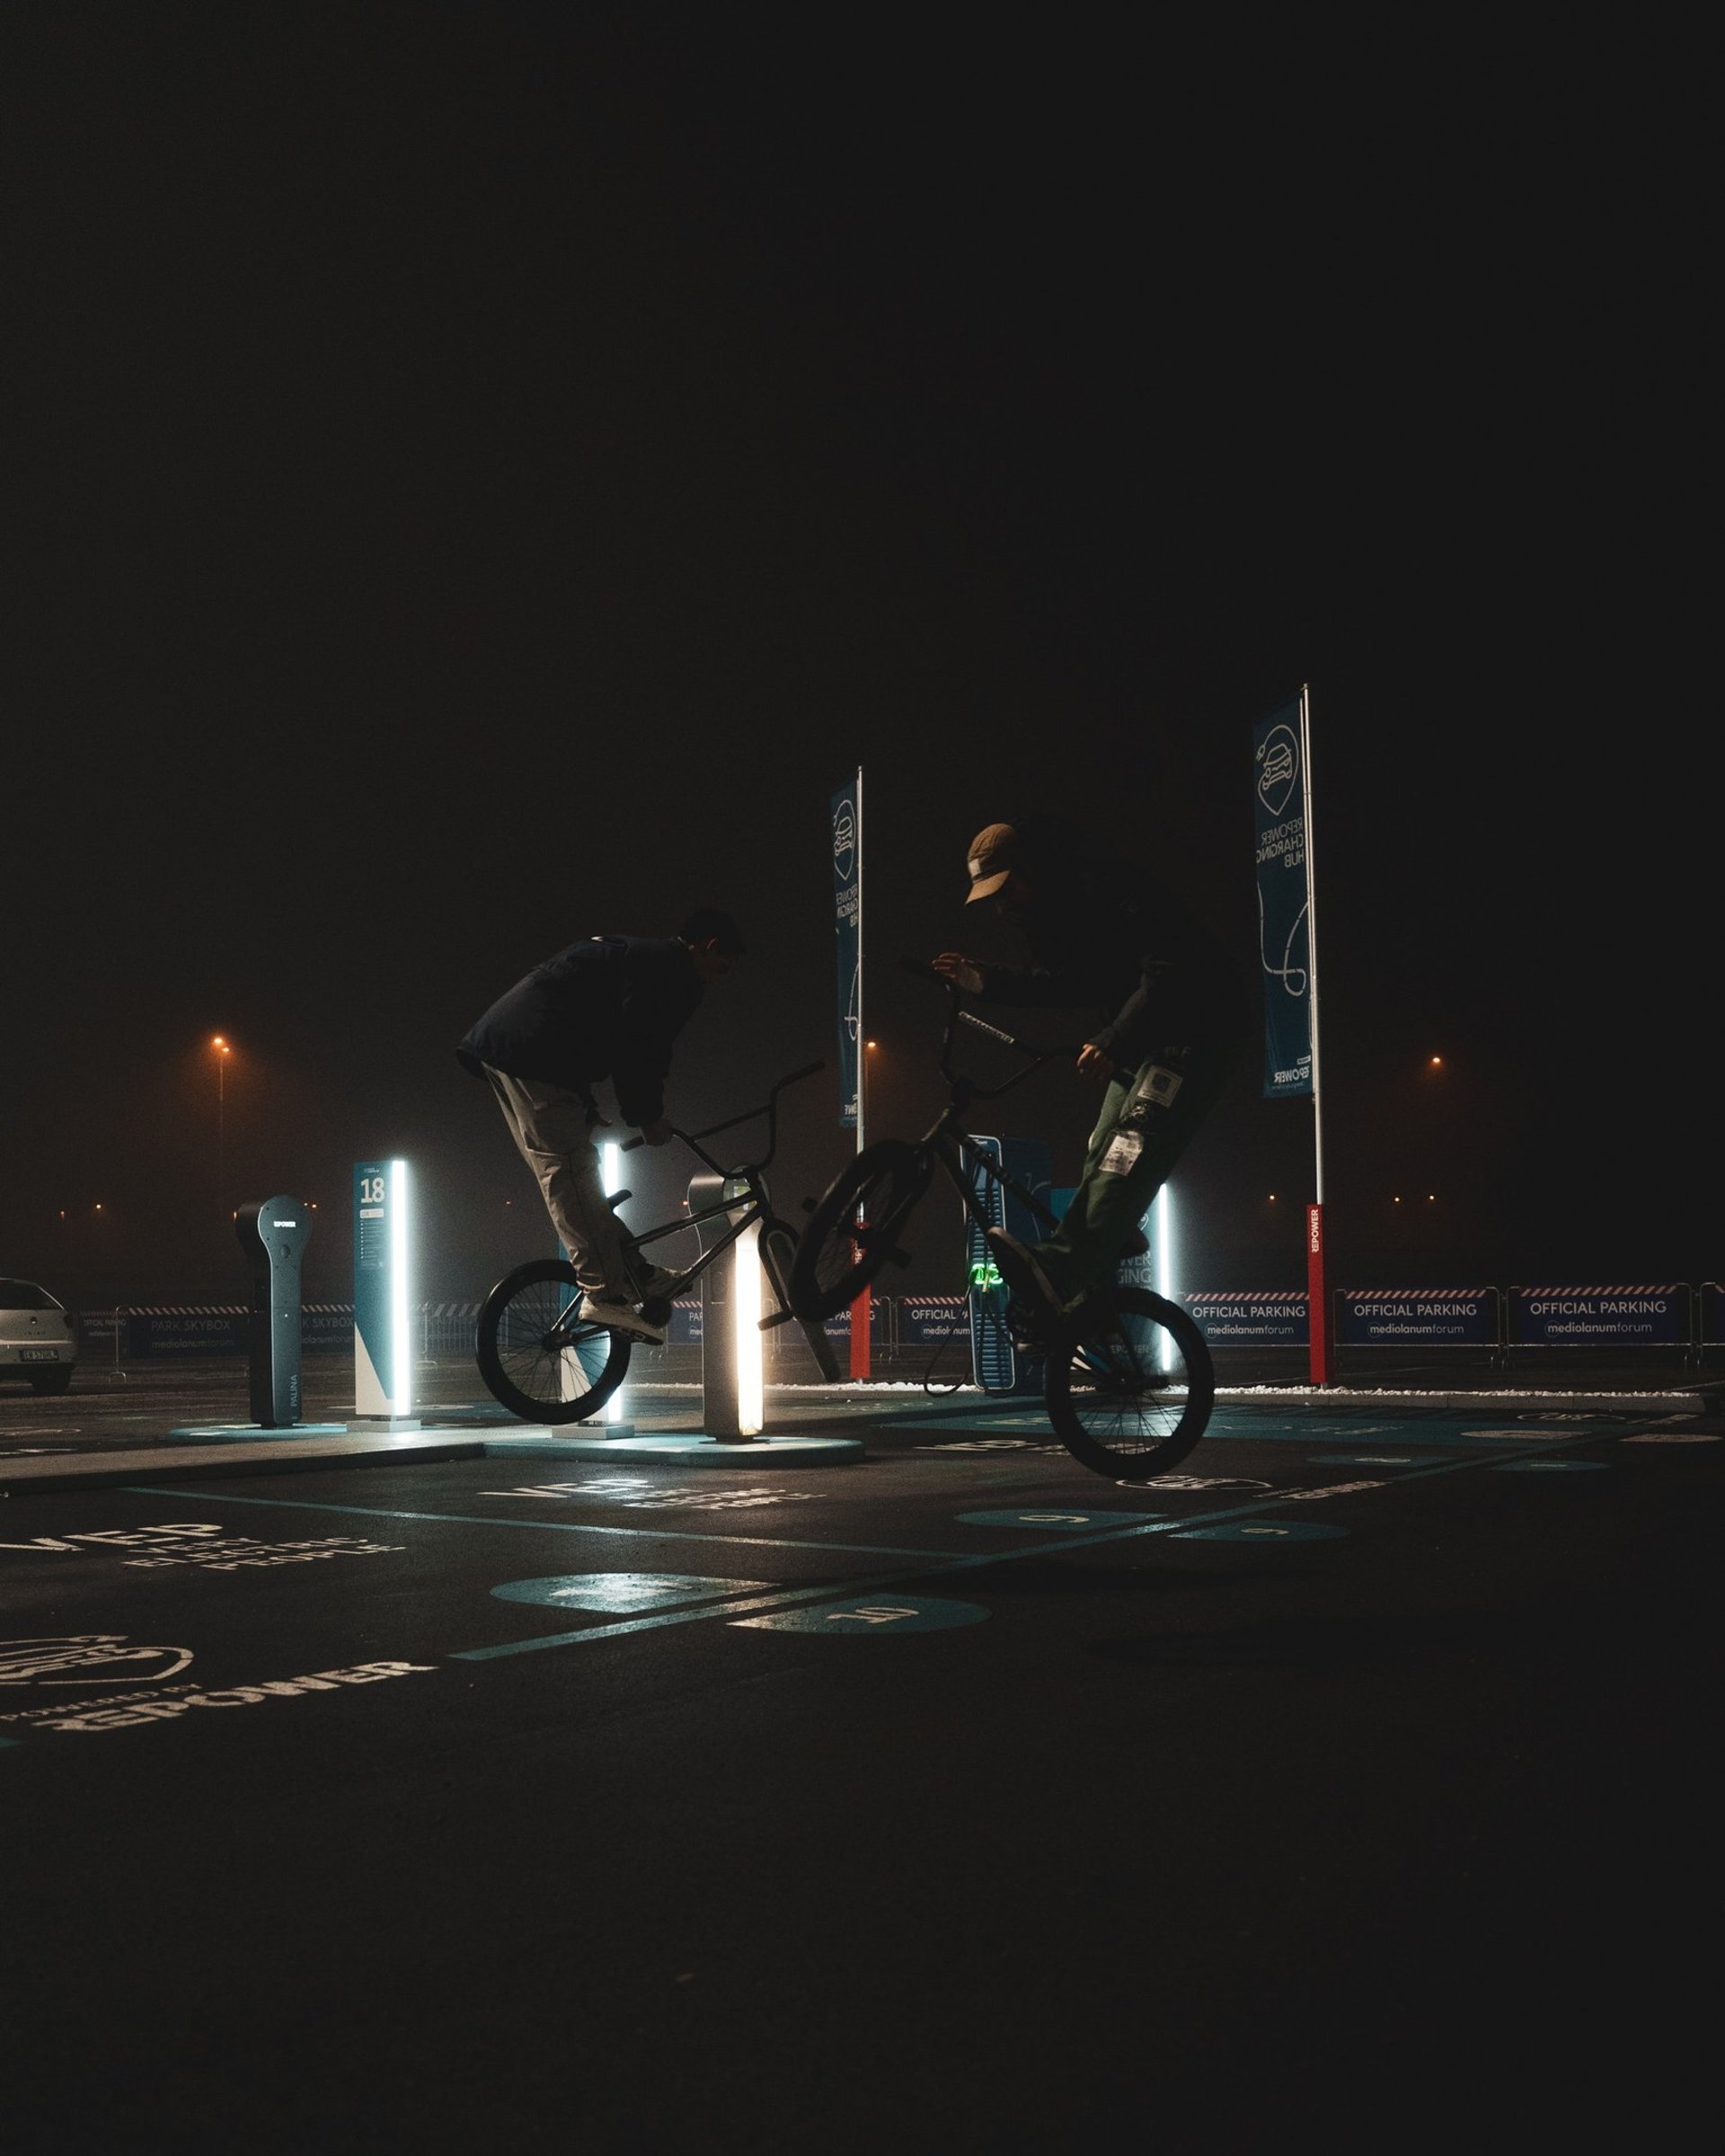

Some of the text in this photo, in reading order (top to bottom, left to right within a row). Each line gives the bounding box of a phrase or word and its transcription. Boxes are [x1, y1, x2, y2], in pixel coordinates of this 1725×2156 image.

[360, 1177, 385, 1203] 18
[911, 1309, 957, 1321] OFFICIAL
[1192, 1305, 1306, 1319] OFFICIAL PARKING
[1354, 1303, 1478, 1317] OFFICIAL PARKING
[1529, 1301, 1668, 1315] OFFICIAL PARKING
[151, 1320, 231, 1332] PARK SKYBOX
[312, 1317, 354, 1329] SKYBOX
[1207, 1324, 1295, 1336] mediolanumforum
[1369, 1323, 1464, 1335] mediolanumforum
[1547, 1321, 1653, 1334] mediolanumforum
[290, 1374, 298, 1408] PALINA
[477, 1479, 654, 1498] VEP
[0, 1524, 223, 1551] VEP
[120, 1537, 368, 1568] ELECTRIC
[126, 1537, 261, 1554] VERY
[199, 1544, 407, 1571] PEOPLE
[0, 1683, 202, 1722] POWERED BY
[31, 1661, 440, 1731] REPOWER
